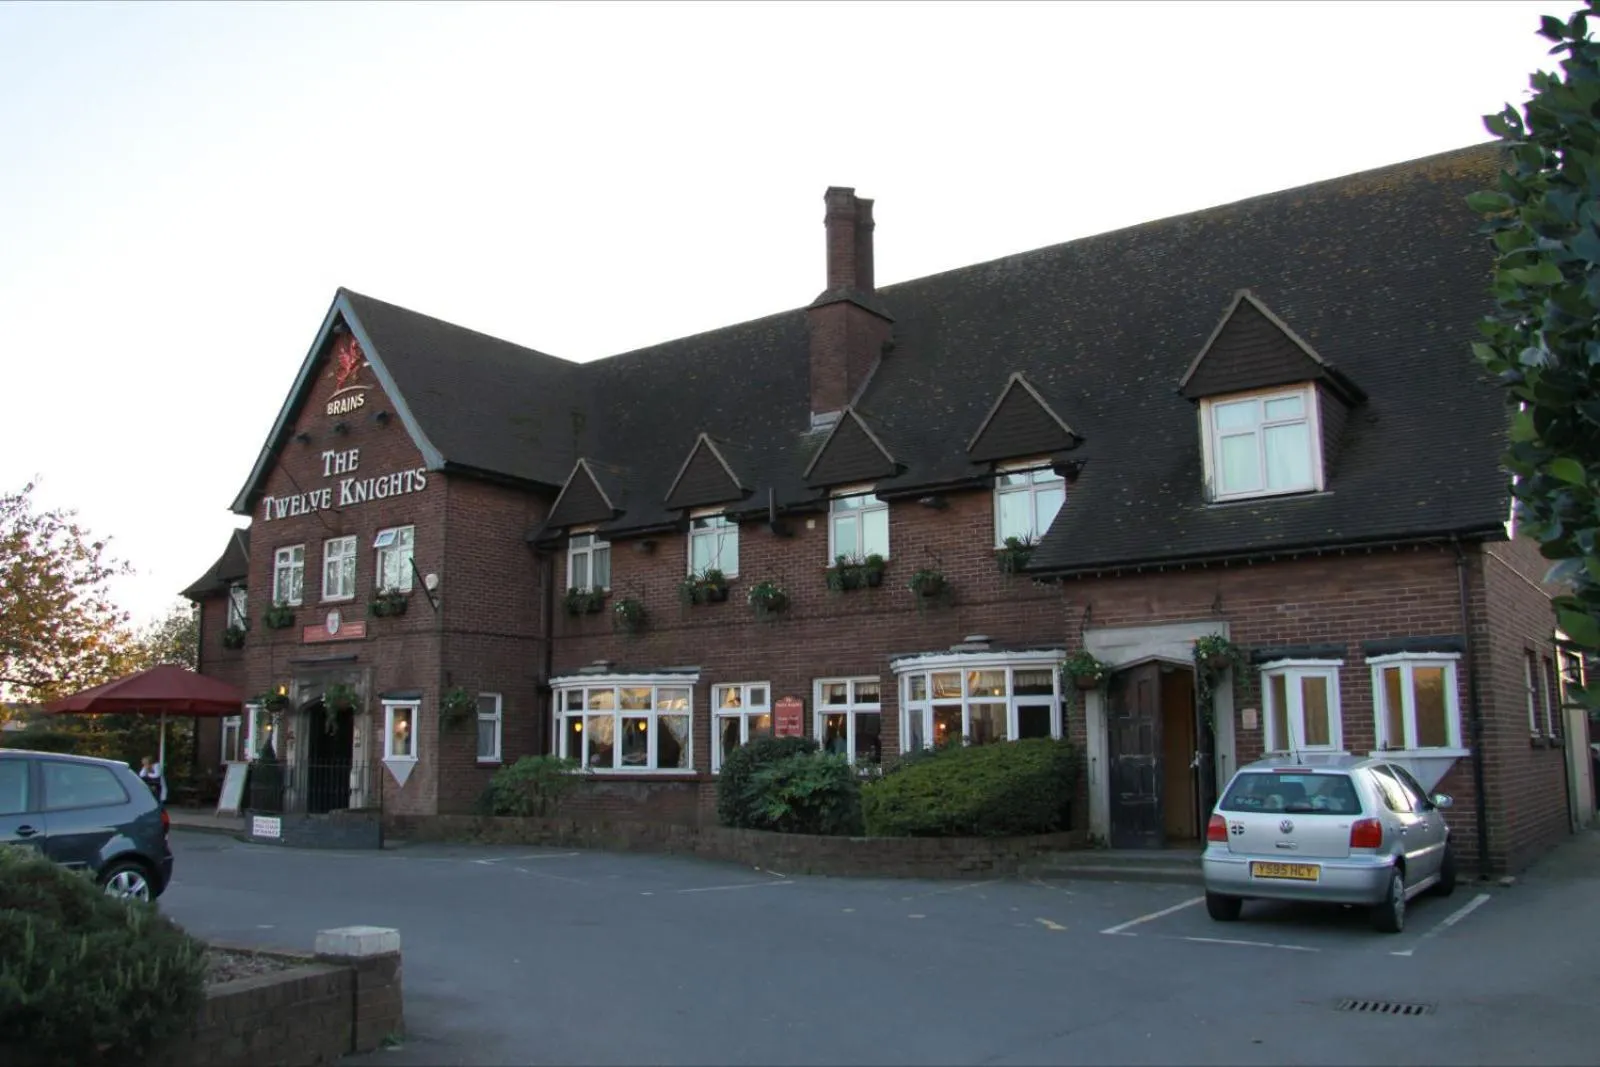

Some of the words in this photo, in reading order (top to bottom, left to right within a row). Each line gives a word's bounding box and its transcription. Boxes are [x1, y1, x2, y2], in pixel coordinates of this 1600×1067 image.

[327, 393, 365, 415] BRAINS
[322, 449, 359, 477] THE
[263, 488, 332, 521] TWELVE
[339, 467, 427, 506] KNIGHTS
